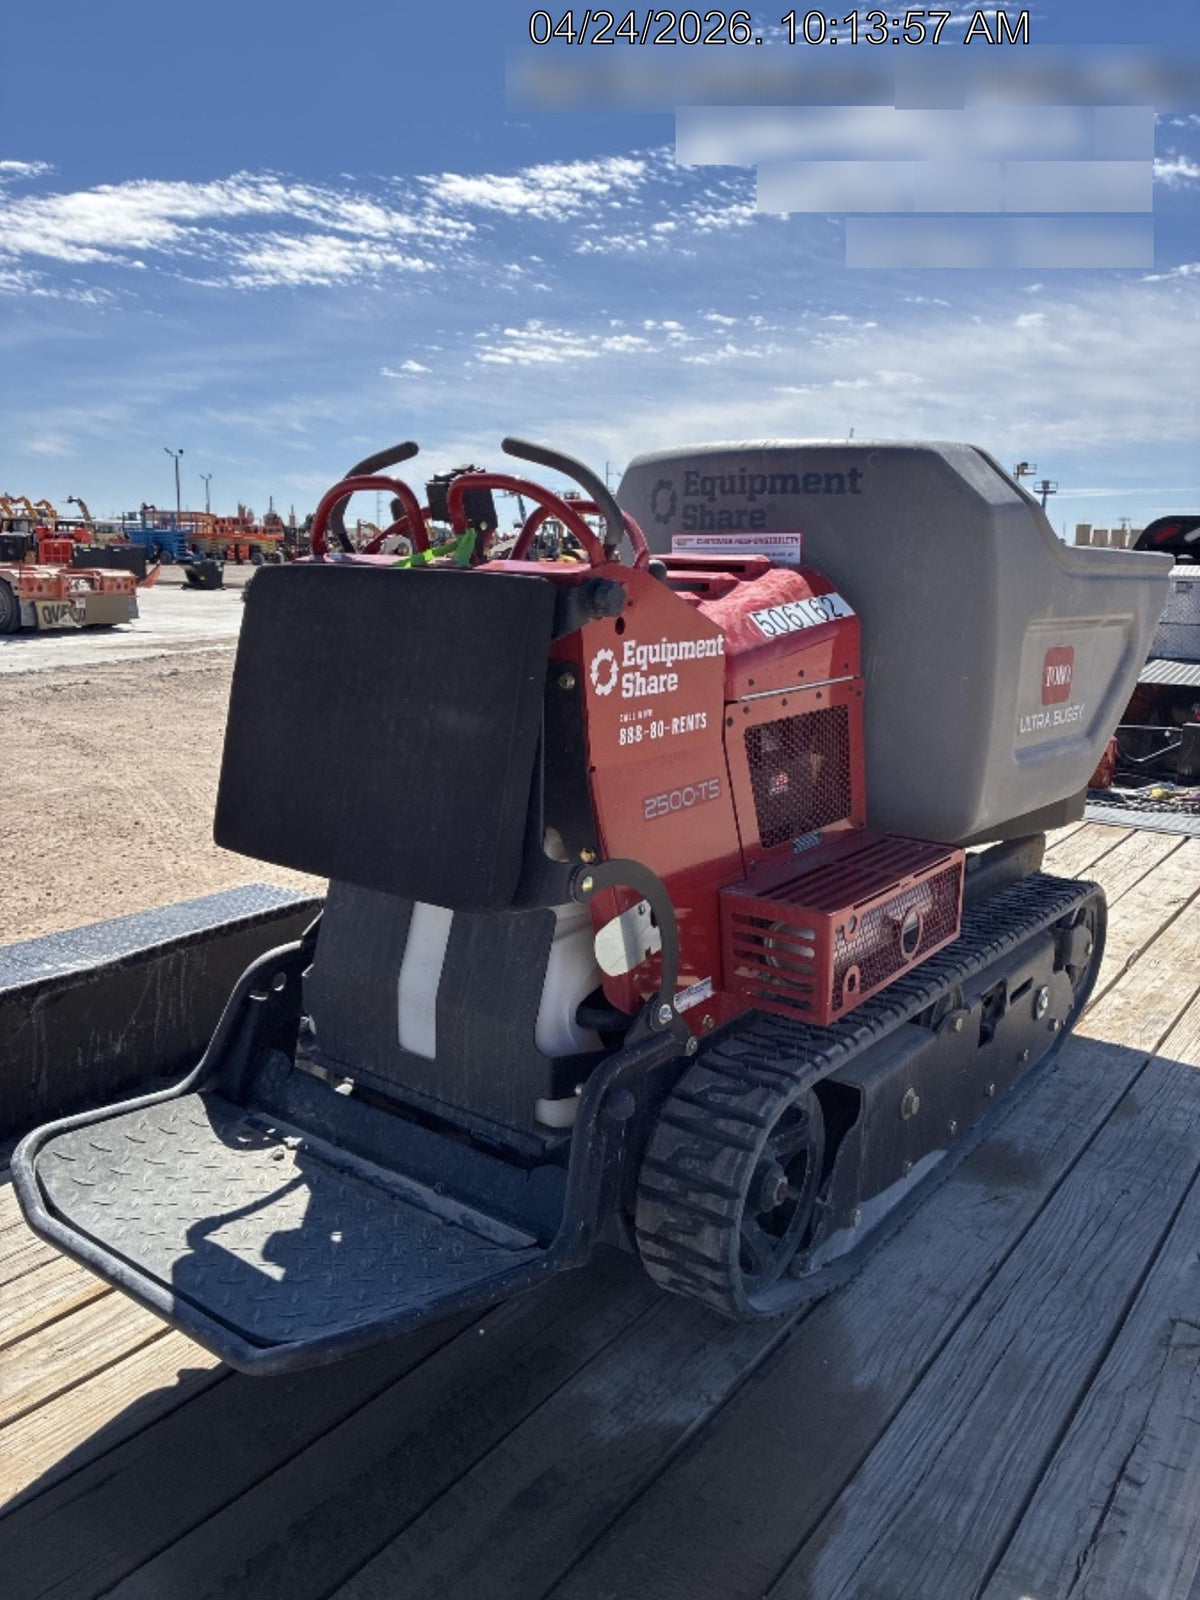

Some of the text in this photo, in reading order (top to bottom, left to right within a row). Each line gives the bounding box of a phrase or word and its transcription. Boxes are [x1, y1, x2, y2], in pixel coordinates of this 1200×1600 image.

[682, 467, 863, 501] Equipment
[681, 503, 767, 530] Share
[752, 596, 843, 636] 506162
[622, 634, 725, 670] Equipment
[621, 671, 678, 698] Share
[619, 711, 707, 746] 888-80-RENTS
[1020, 711, 1052, 733] ULTRA
